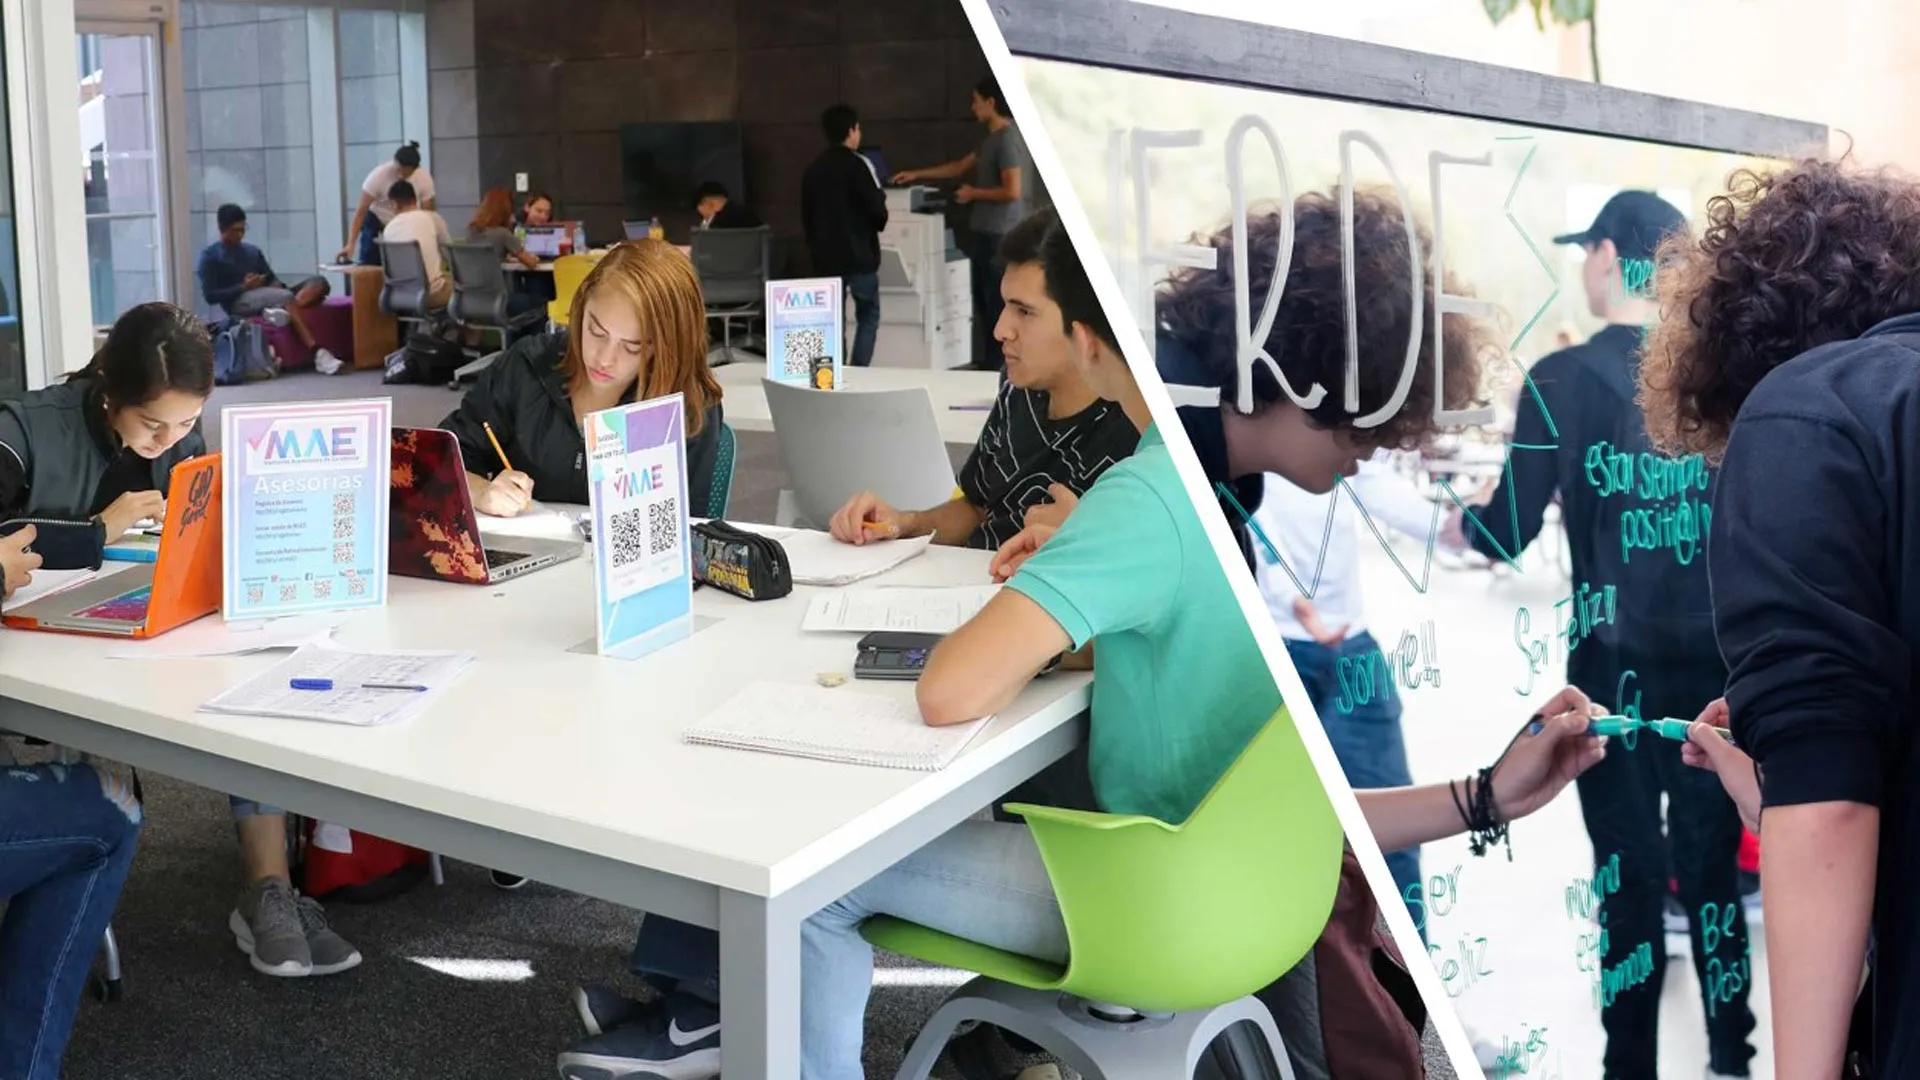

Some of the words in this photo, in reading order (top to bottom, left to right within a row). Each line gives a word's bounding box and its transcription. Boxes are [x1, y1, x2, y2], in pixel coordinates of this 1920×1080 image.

[784, 291, 826, 307] MAE
[264, 427, 357, 460] MAE
[622, 464, 664, 499] MAE
[1700, 902, 1737, 955] Be
